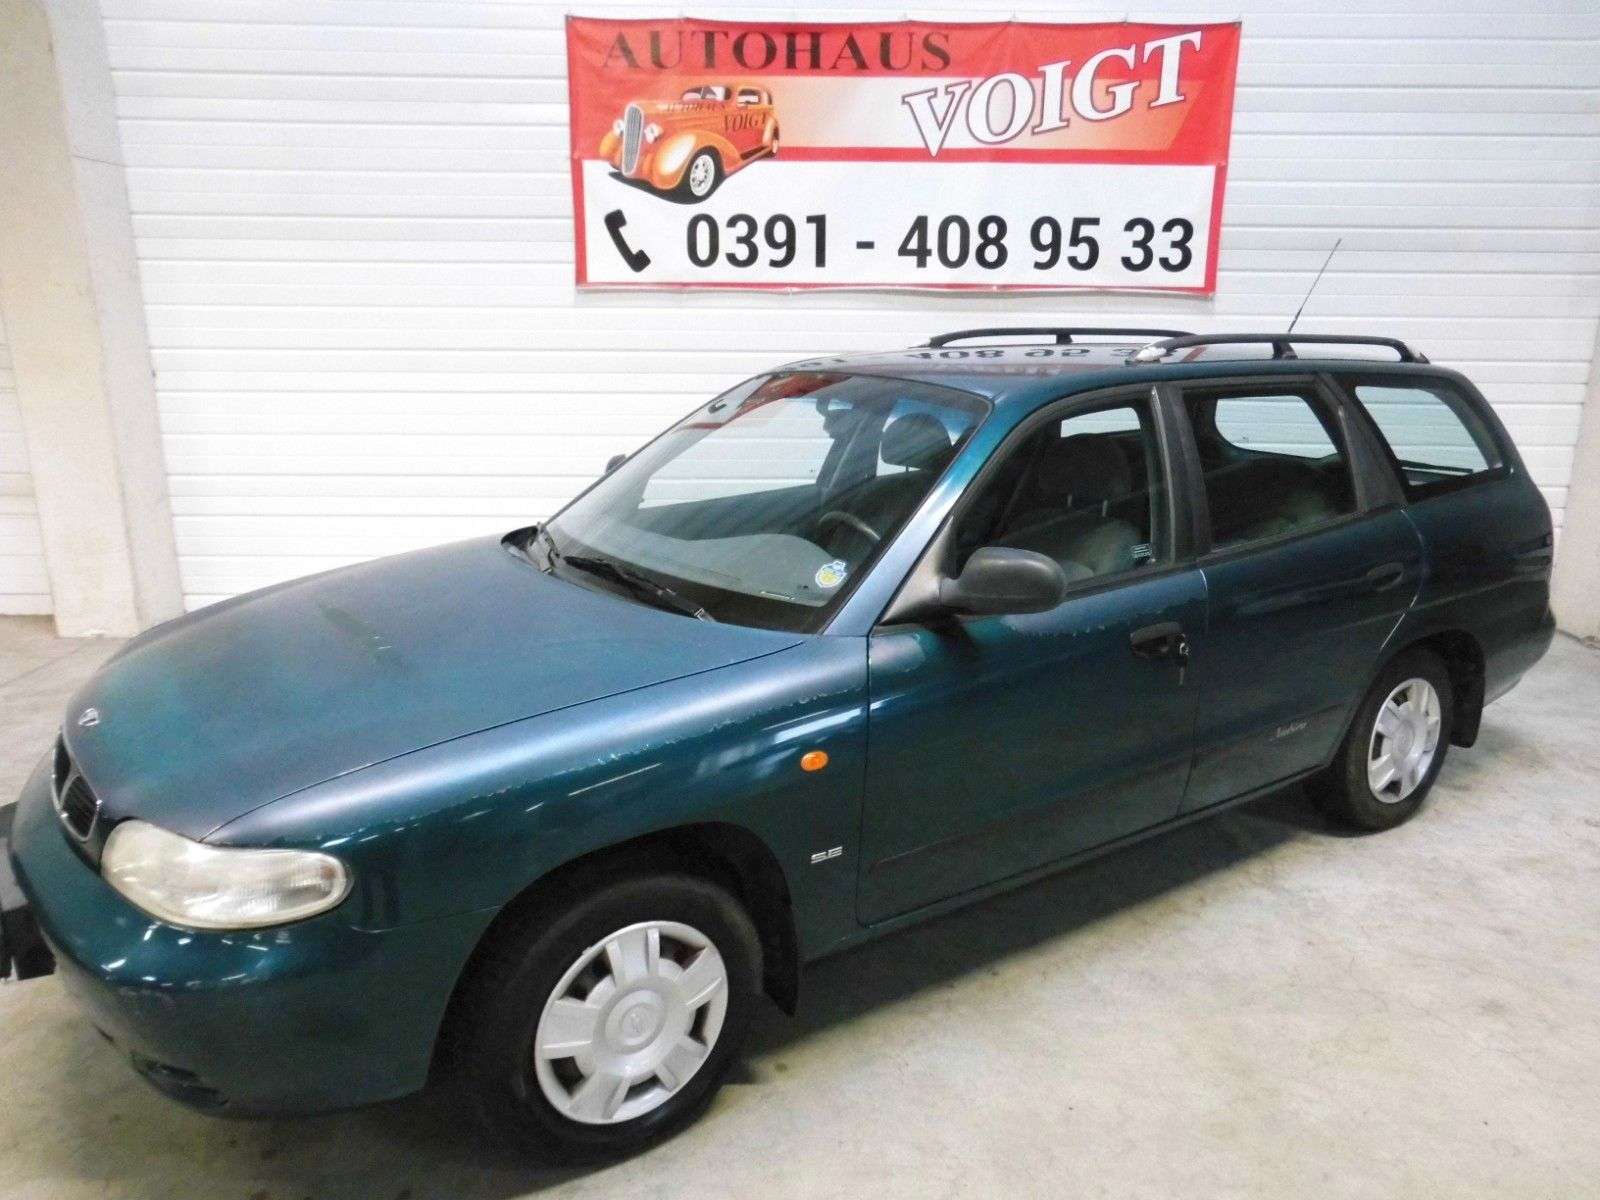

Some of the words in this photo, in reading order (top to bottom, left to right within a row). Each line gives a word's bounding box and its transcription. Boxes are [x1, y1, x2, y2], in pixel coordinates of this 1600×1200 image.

[602, 29, 951, 71] AUTOHAUS
[902, 29, 1203, 157] VOIGT
[687, 213, 827, 268] 0391
[856, 241, 874, 249] -
[897, 215, 1008, 270] 408
[1030, 216, 1100, 271] 95
[1121, 217, 1194, 273] 33
